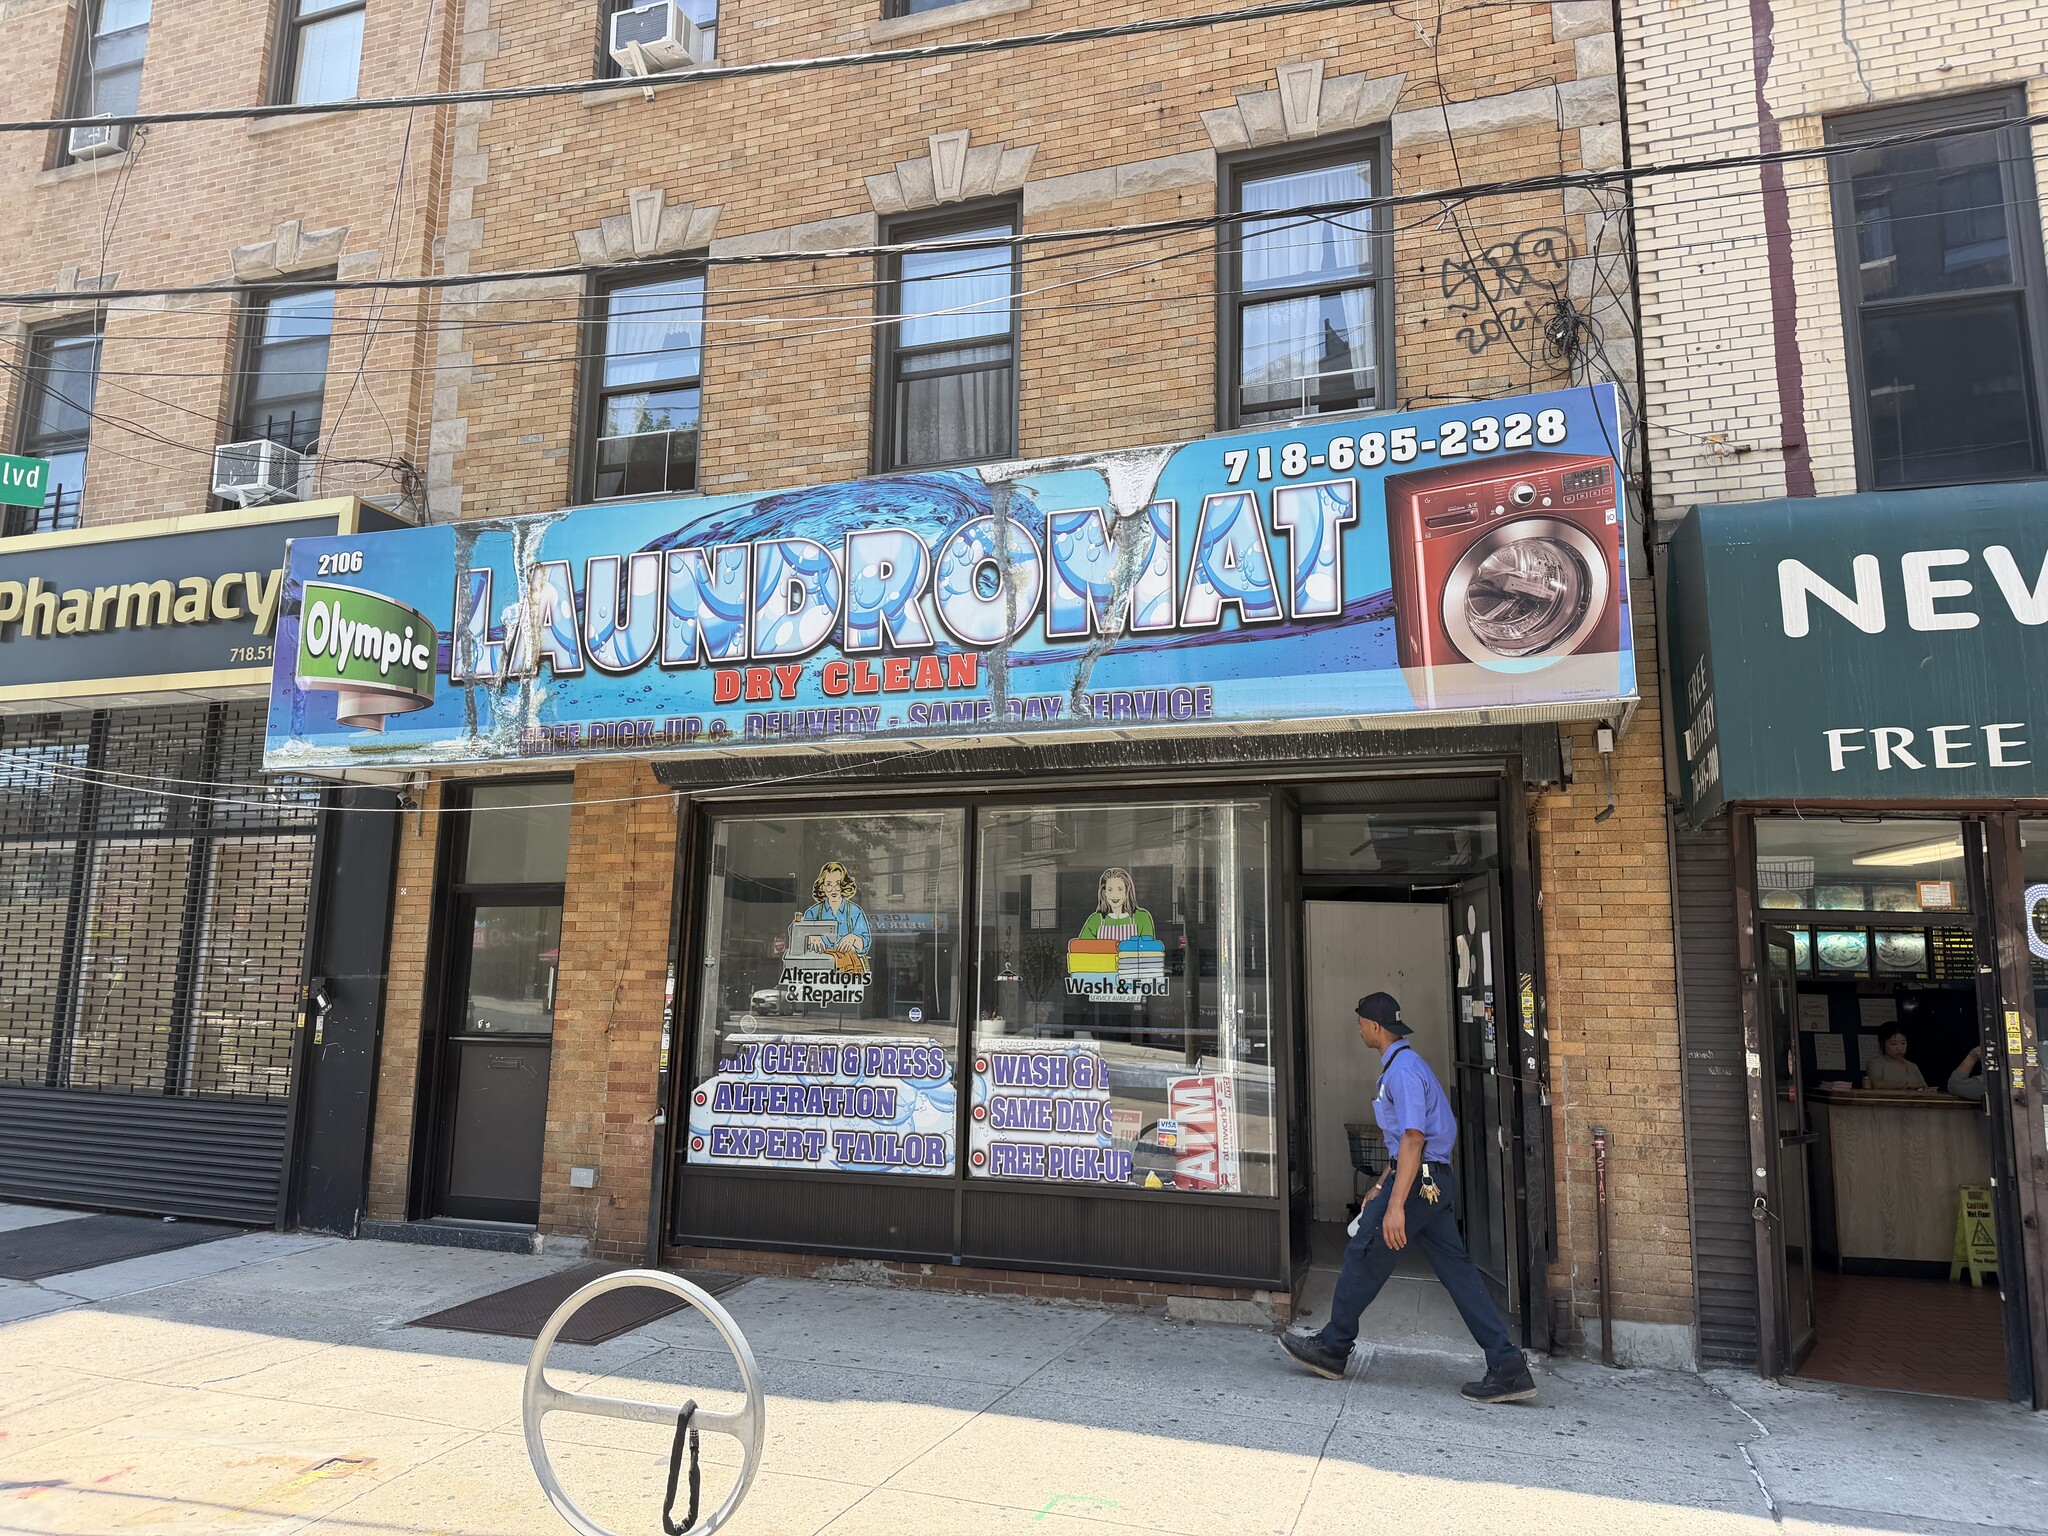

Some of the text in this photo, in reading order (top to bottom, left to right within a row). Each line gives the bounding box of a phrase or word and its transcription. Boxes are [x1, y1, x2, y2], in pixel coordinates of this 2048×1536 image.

[1224, 408, 1567, 482] 718-685-2328
[317, 551, 363, 576] 2106
[450, 478, 1357, 682] LAUNDROMAT
[0, 568, 282, 639] Pharmacy
[306, 600, 430, 675] Olympic
[713, 653, 978, 703] DRY CLEAN
[521, 724, 580, 754] FREE
[588, 717, 703, 750] PICK-UP
[744, 706, 880, 741] DELIVERY
[909, 699, 991, 728] SAME
[1005, 697, 1062, 721] DAY
[1822, 723, 2031, 772] FREE
[780, 967, 872, 985] Alterations
[1065, 977, 1169, 995] Wash & Fold
[786, 985, 863, 1008] & Repairs
[763, 1044, 837, 1075] CLEAN
[843, 1046, 859, 1075] &
[865, 1046, 944, 1078] PRESS
[992, 1054, 1069, 1088] WASH
[1072, 1056, 1093, 1089] &
[713, 1083, 896, 1117] ALTERATION
[990, 1096, 1052, 1131] SAME
[1056, 1099, 1101, 1133] DAY
[1160, 1121, 1177, 1129] VISA
[1172, 1086, 1218, 1184] ATM
[1220, 1106, 1230, 1162] atmworld
[711, 1127, 945, 1167] EXPERT TAILOR
[989, 1143, 1132, 1182] FREE PICK-UP
